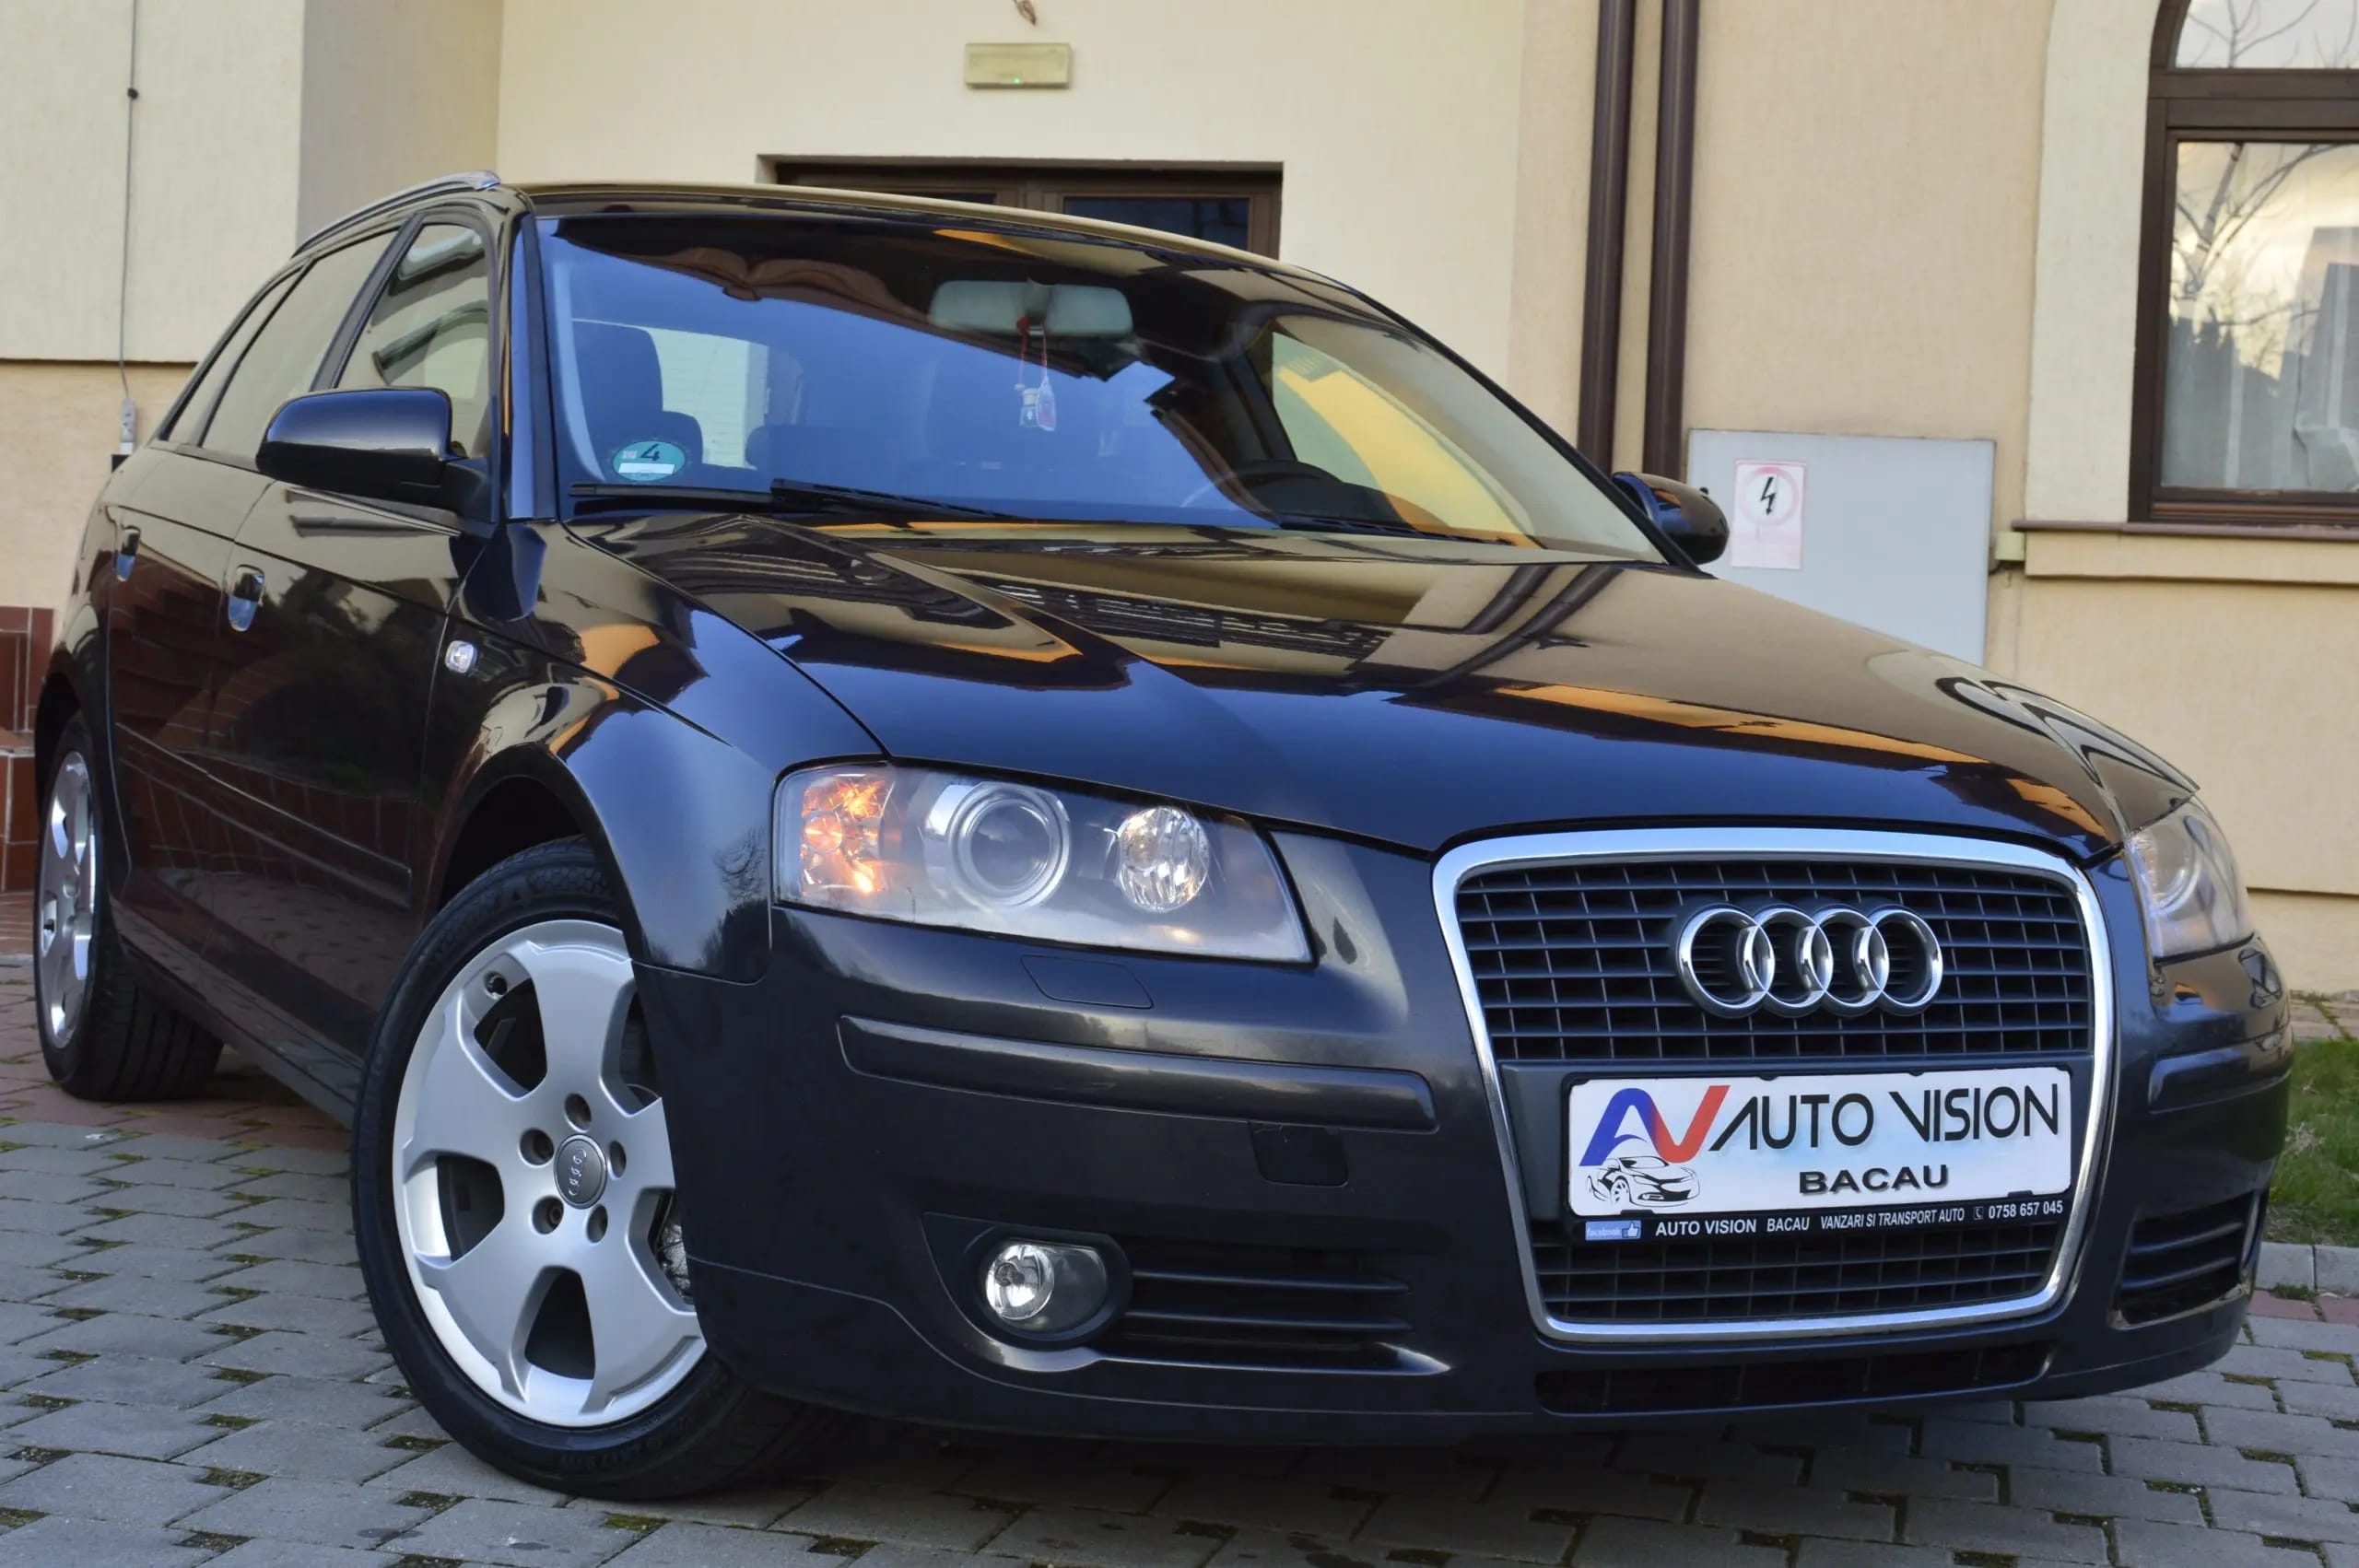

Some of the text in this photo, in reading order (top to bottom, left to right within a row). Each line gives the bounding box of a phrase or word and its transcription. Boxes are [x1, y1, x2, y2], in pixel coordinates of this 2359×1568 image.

[640, 443, 661, 462] 4
[1708, 1082, 2059, 1153] AUTO VISION
[1798, 1164, 1950, 1196] BACAU
[1820, 1207, 1966, 1230] VANZARI SI TRANSPORT AUTO
[1988, 1199, 2064, 1220] 0758 657 045
[1655, 1218, 1757, 1237] AUTO VISION
[1766, 1216, 1811, 1233] BACAU
